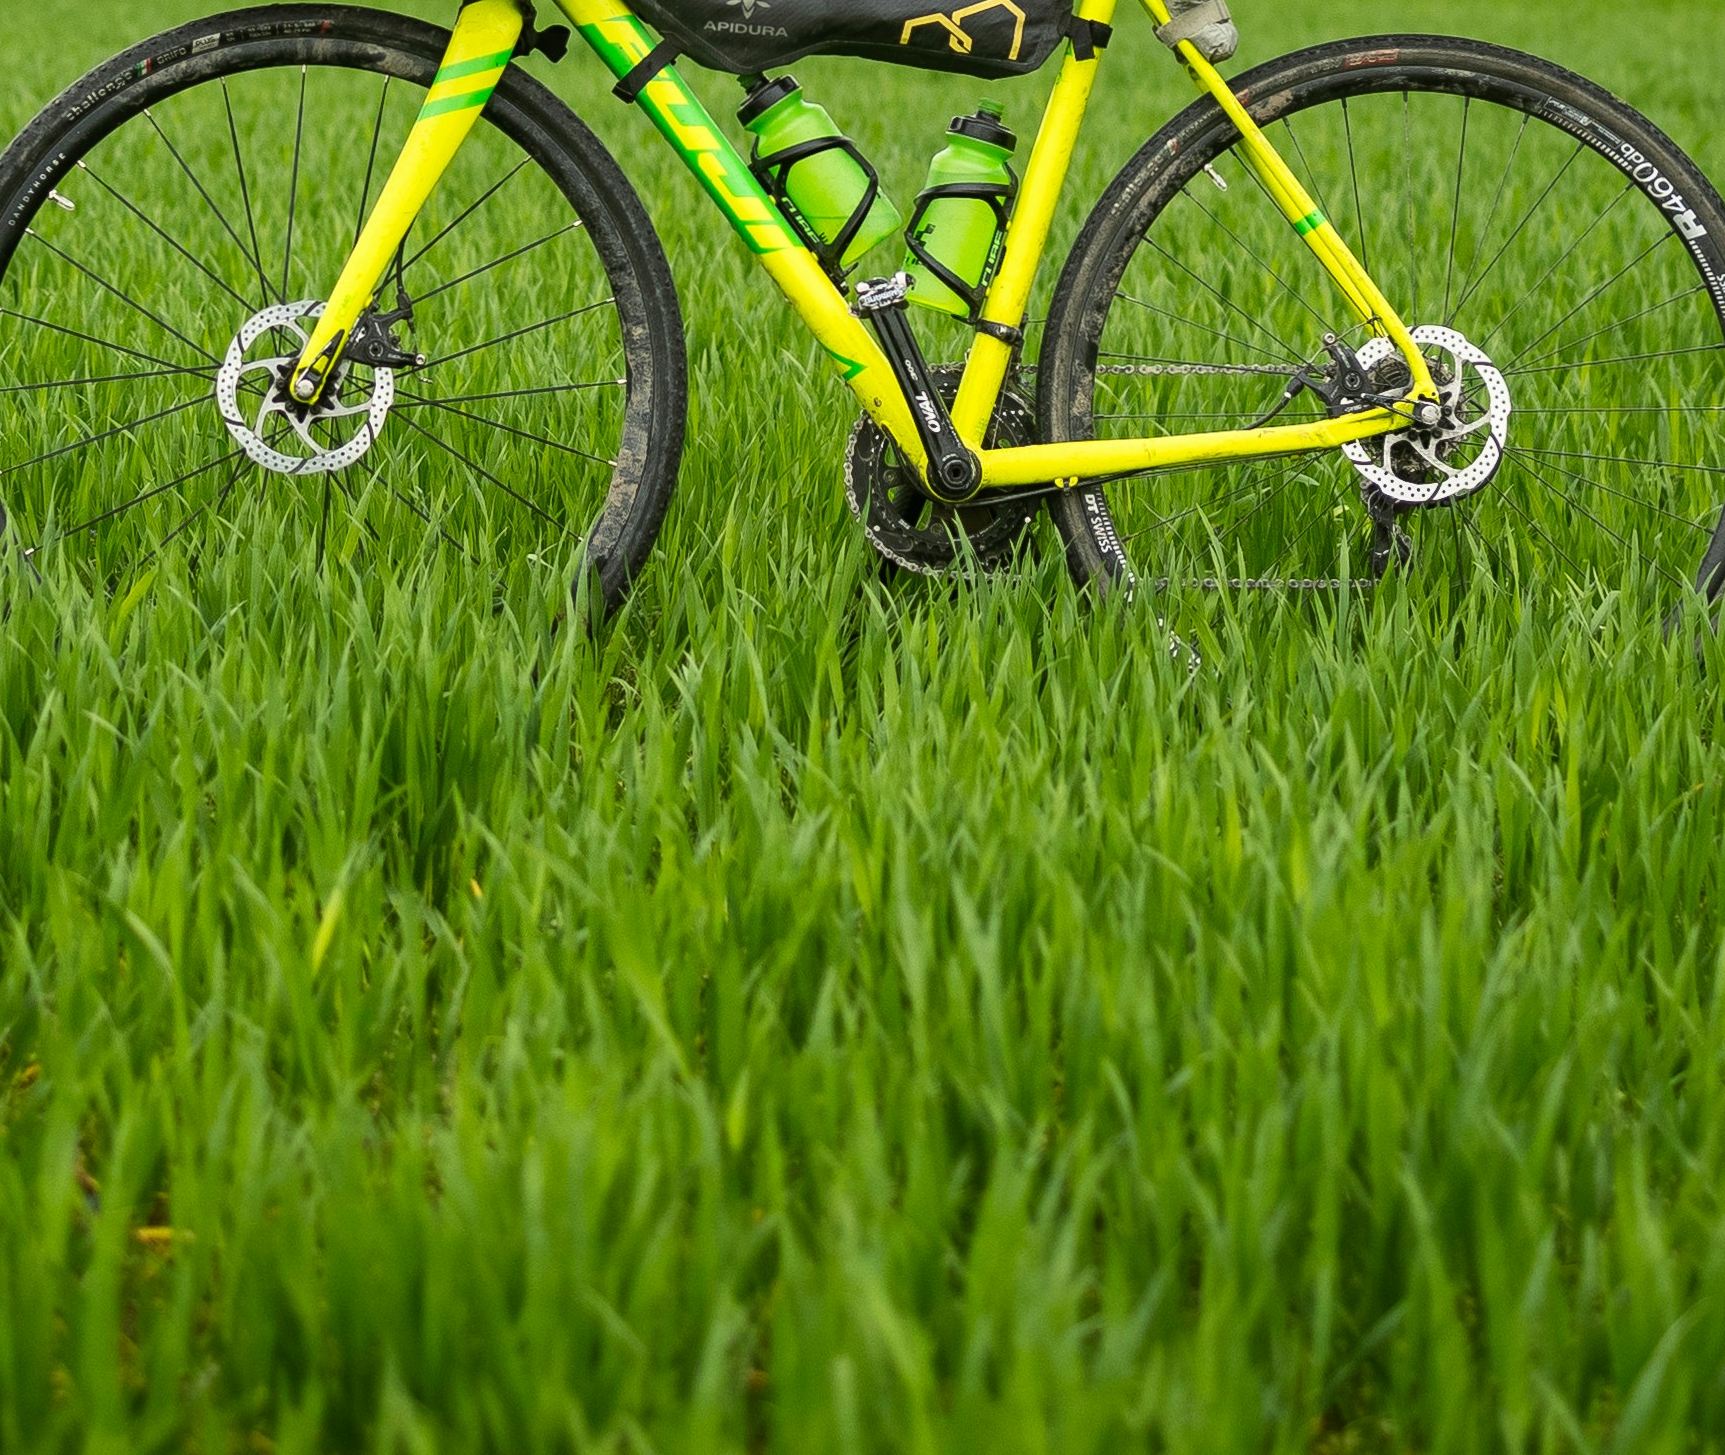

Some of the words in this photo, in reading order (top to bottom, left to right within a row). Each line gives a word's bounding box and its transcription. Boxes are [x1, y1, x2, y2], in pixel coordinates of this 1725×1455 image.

[703, 20, 789, 38] APIDURA
[8, 151, 67, 227] DANDYHORSE
[915, 390, 941, 434] OVAL
[1084, 493, 1100, 515] DT
[1090, 515, 1113, 554] SWISS
